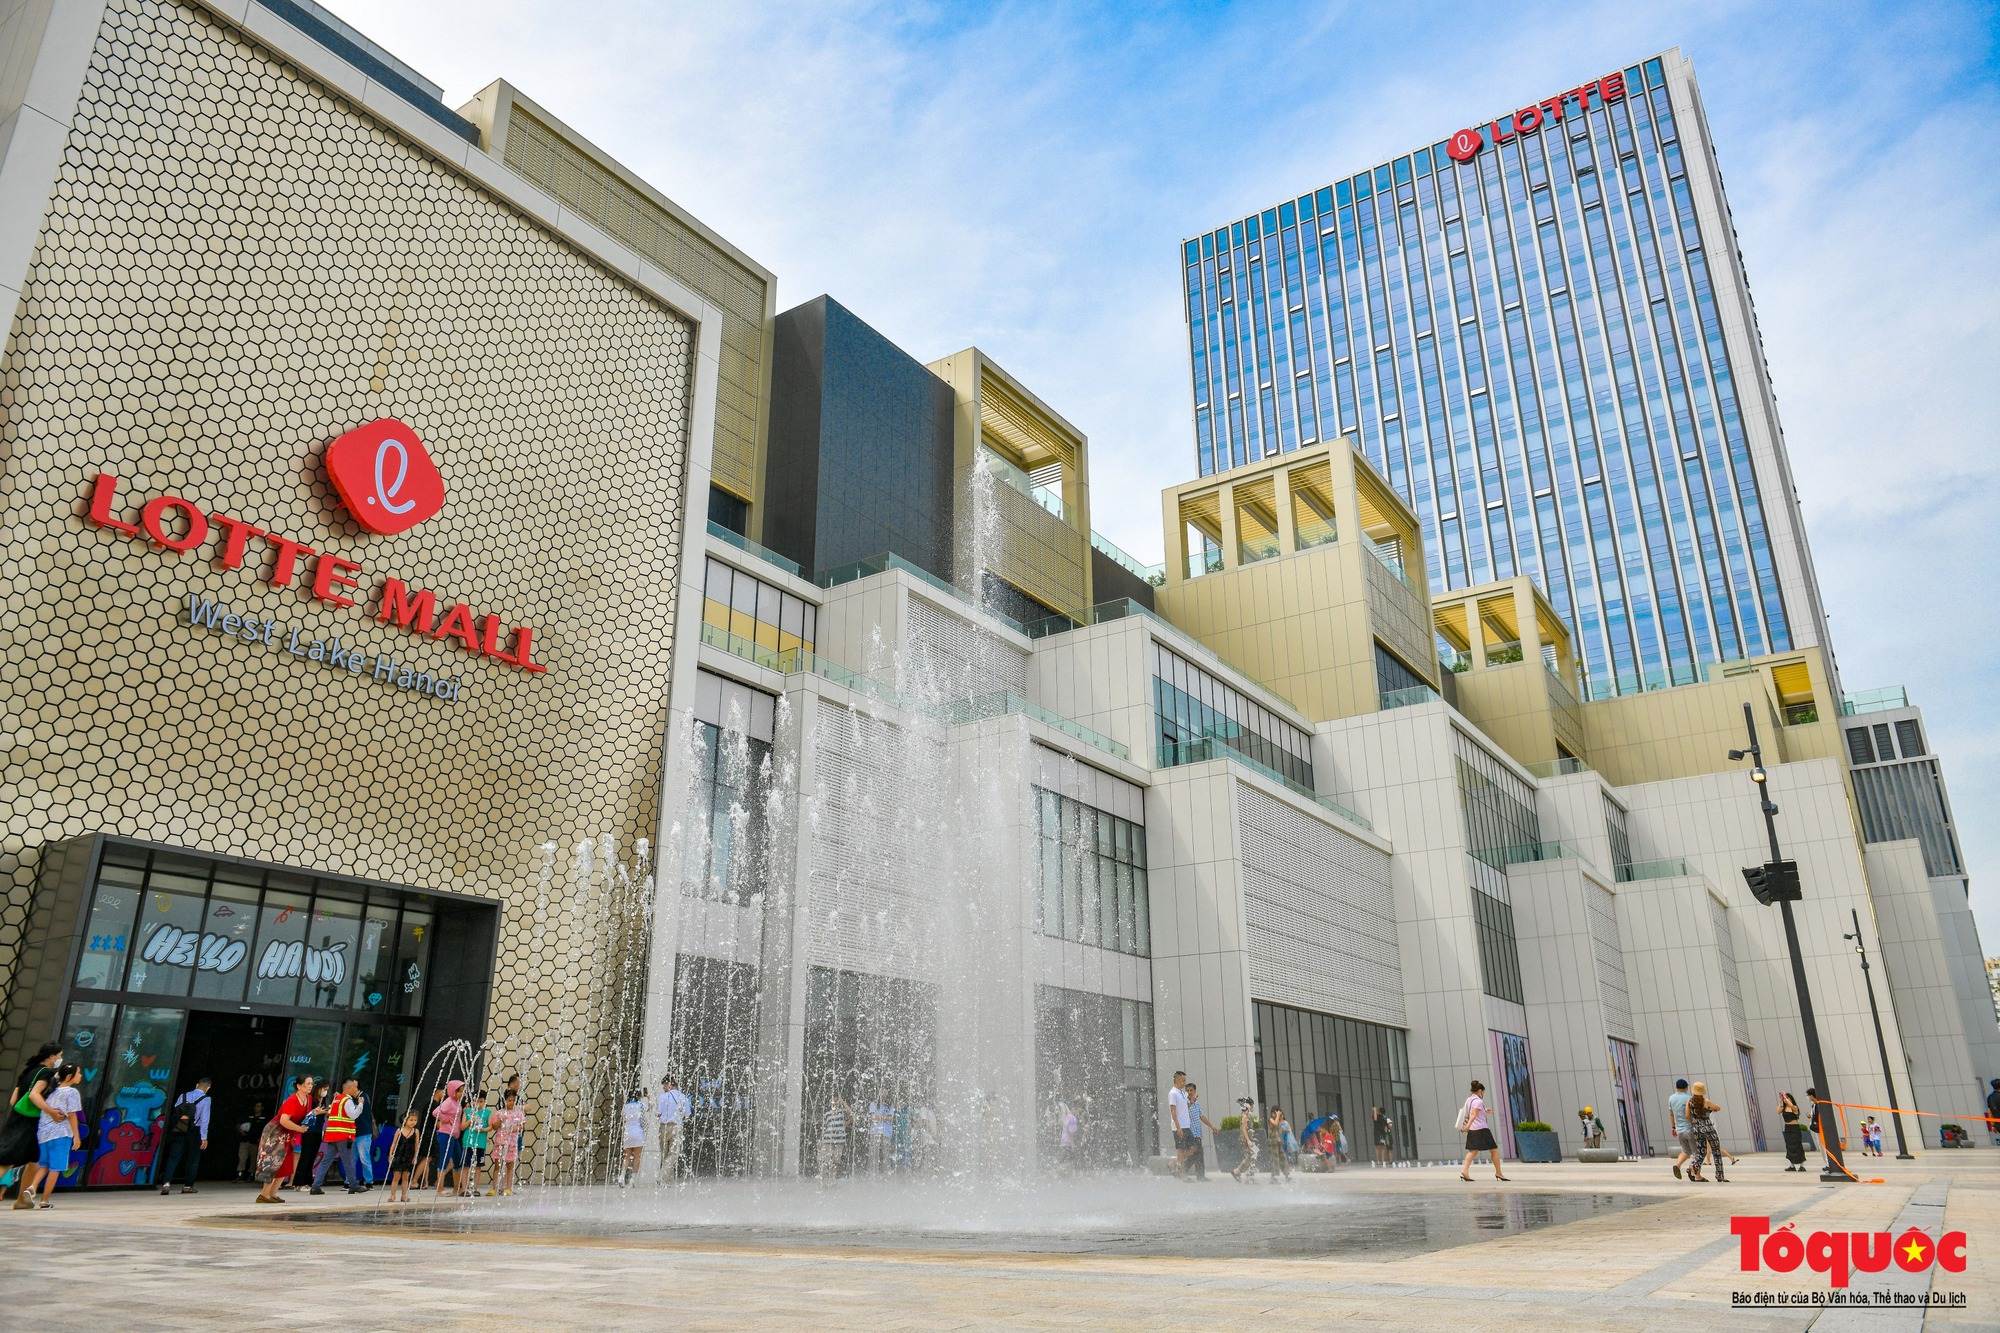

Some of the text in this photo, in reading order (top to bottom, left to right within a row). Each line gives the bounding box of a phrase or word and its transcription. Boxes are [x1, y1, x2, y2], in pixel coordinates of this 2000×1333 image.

[1490, 72, 1626, 143] LOTTE
[90, 473, 548, 673] LOTTE MALL
[189, 594, 462, 702] West Lake Hanoi
[141, 923, 248, 974] HELLO
